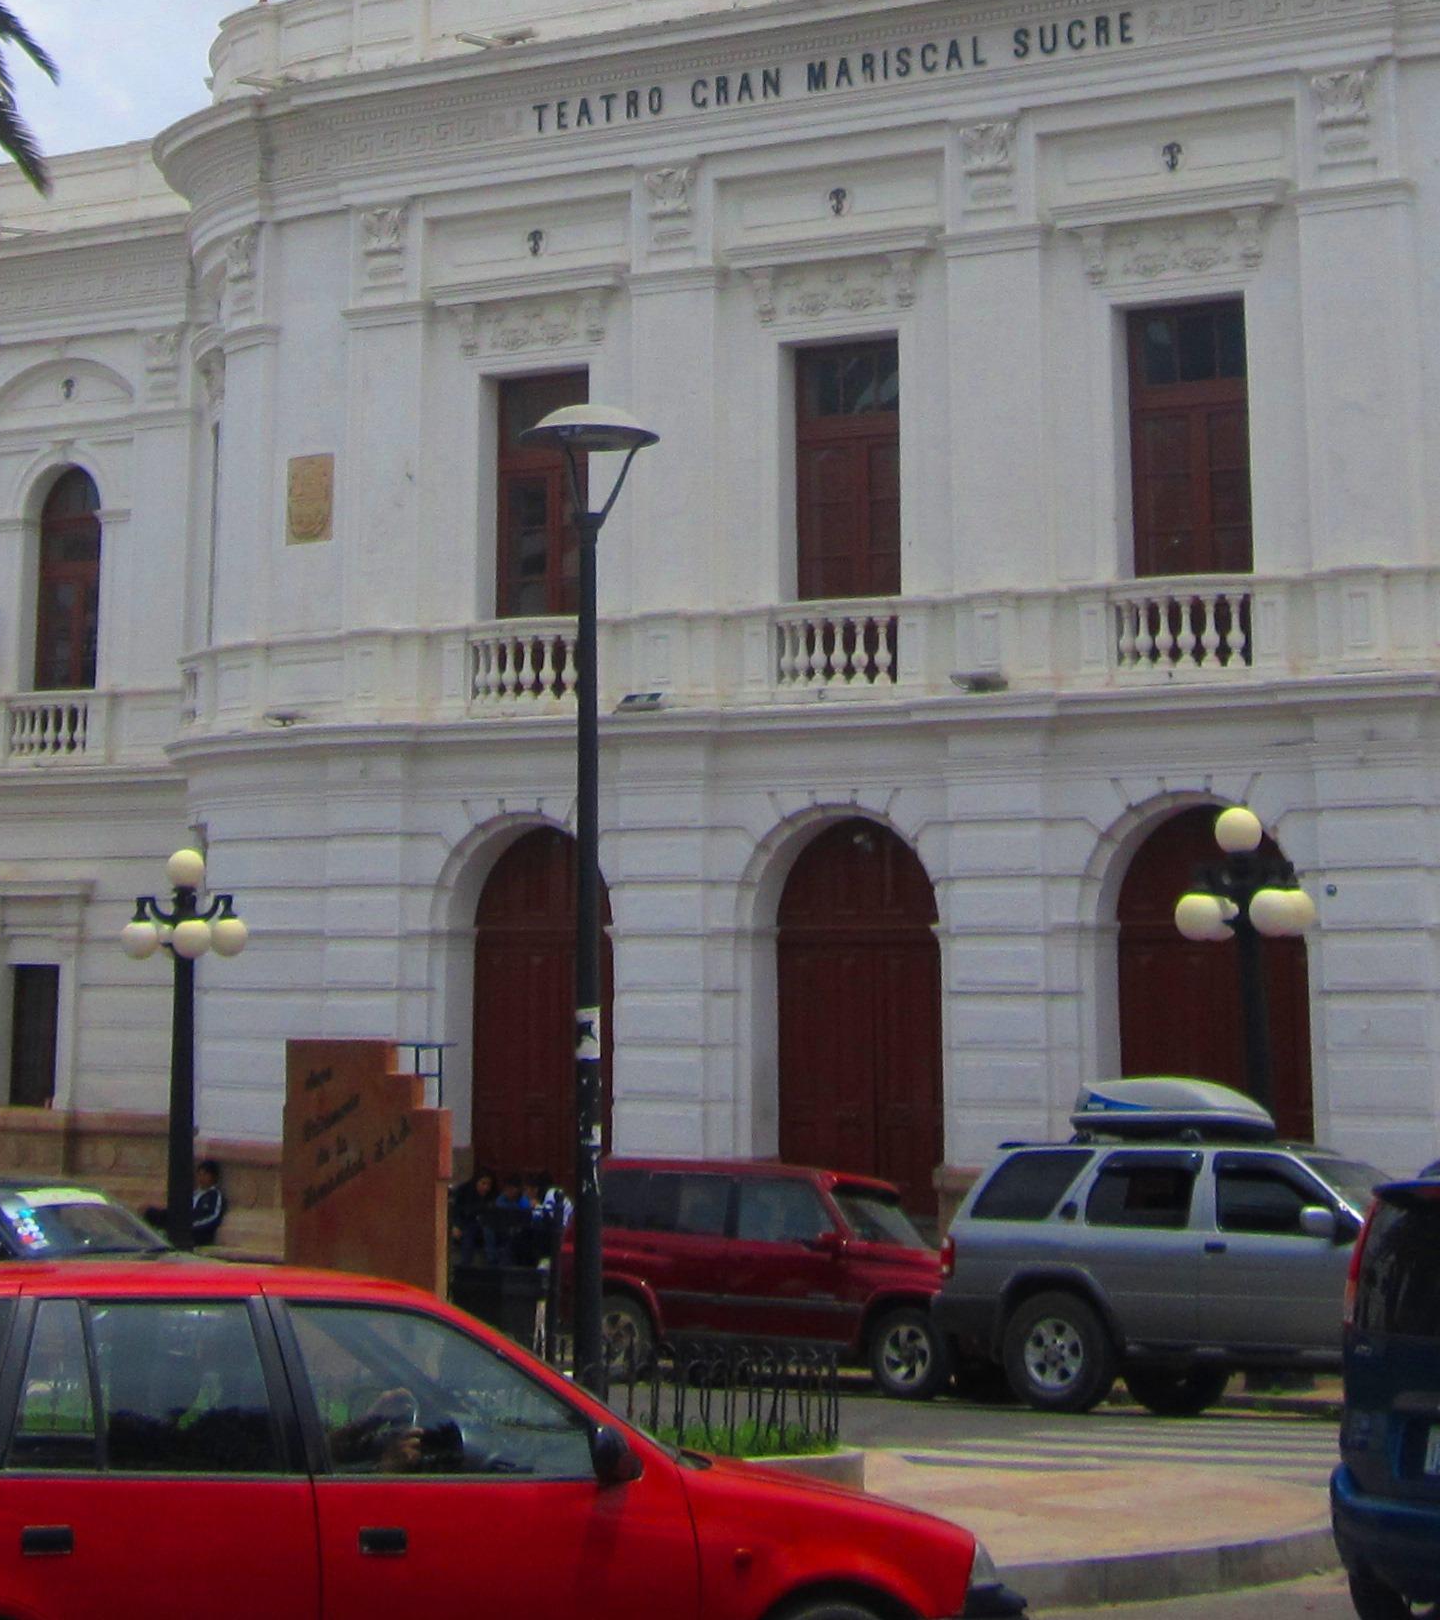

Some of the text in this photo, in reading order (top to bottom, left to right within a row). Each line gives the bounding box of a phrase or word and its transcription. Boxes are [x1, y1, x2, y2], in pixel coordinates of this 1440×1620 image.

[532, 11, 1135, 133] TEATRO GRAN MARISCAL SUCRE
